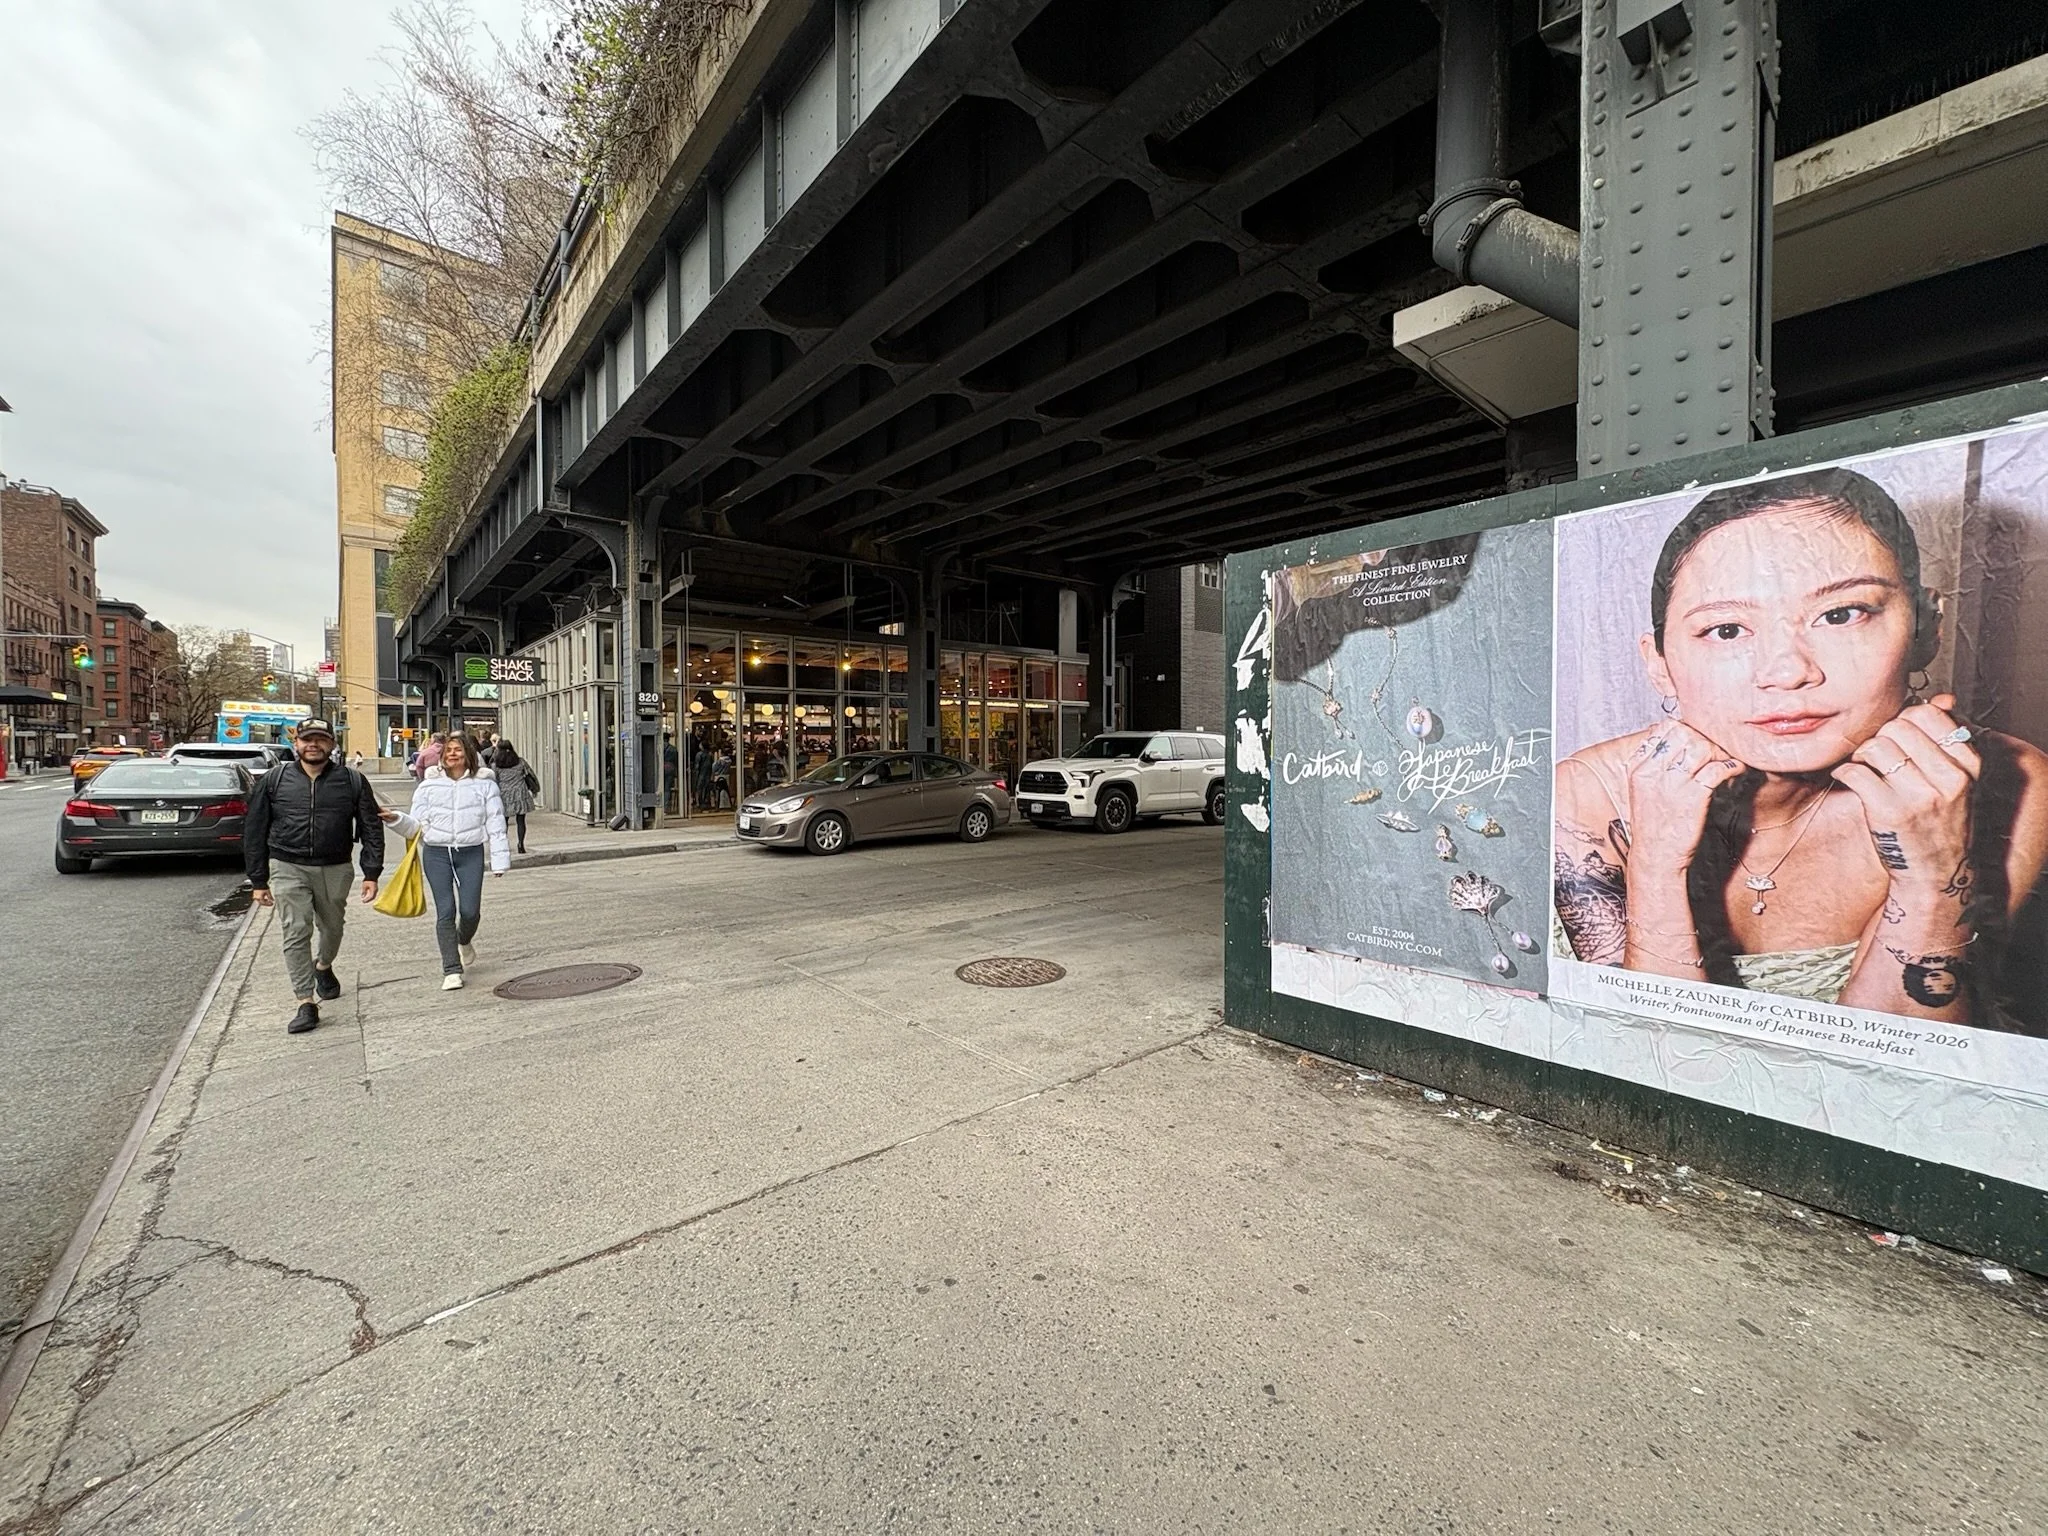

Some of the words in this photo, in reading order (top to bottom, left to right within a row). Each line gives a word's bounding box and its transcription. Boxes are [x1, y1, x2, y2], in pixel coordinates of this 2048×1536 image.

[1332, 574, 1355, 585] THE
[1355, 567, 1390, 581] FINEST
[1391, 564, 1416, 576] FINE
[1416, 554, 1469, 573] JEWELRY
[1348, 582, 1368, 598] A
[1366, 580, 1406, 596] Limited
[1406, 574, 1448, 590] Edition
[1362, 588, 1432, 607] COLLECTION
[490, 658, 533, 671] SHAKE
[490, 669, 535, 682] SHACK
[638, 692, 659, 703] 820
[1282, 749, 1363, 785] Catbird
[1346, 931, 1443, 957] CATBIRDNYC.COM
[1372, 925, 1391, 938] EST.
[1391, 929, 1415, 941] 2004
[1597, 974, 1673, 997] MICHELLE
[1674, 987, 1743, 1010] ZAUNER
[1745, 1000, 1767, 1017] for
[1769, 1004, 1858, 1032] CATBIRD,
[1863, 1020, 1923, 1042] Winter
[1924, 1031, 1971, 1050] 2026
[1629, 993, 1671, 1012] Writer,
[1671, 1001, 1752, 1027] frontwoman
[1755, 1018, 1770, 1032] of
[1770, 1020, 1836, 1042] Japanese
[1838, 1032, 1916, 1056] Breakfast
